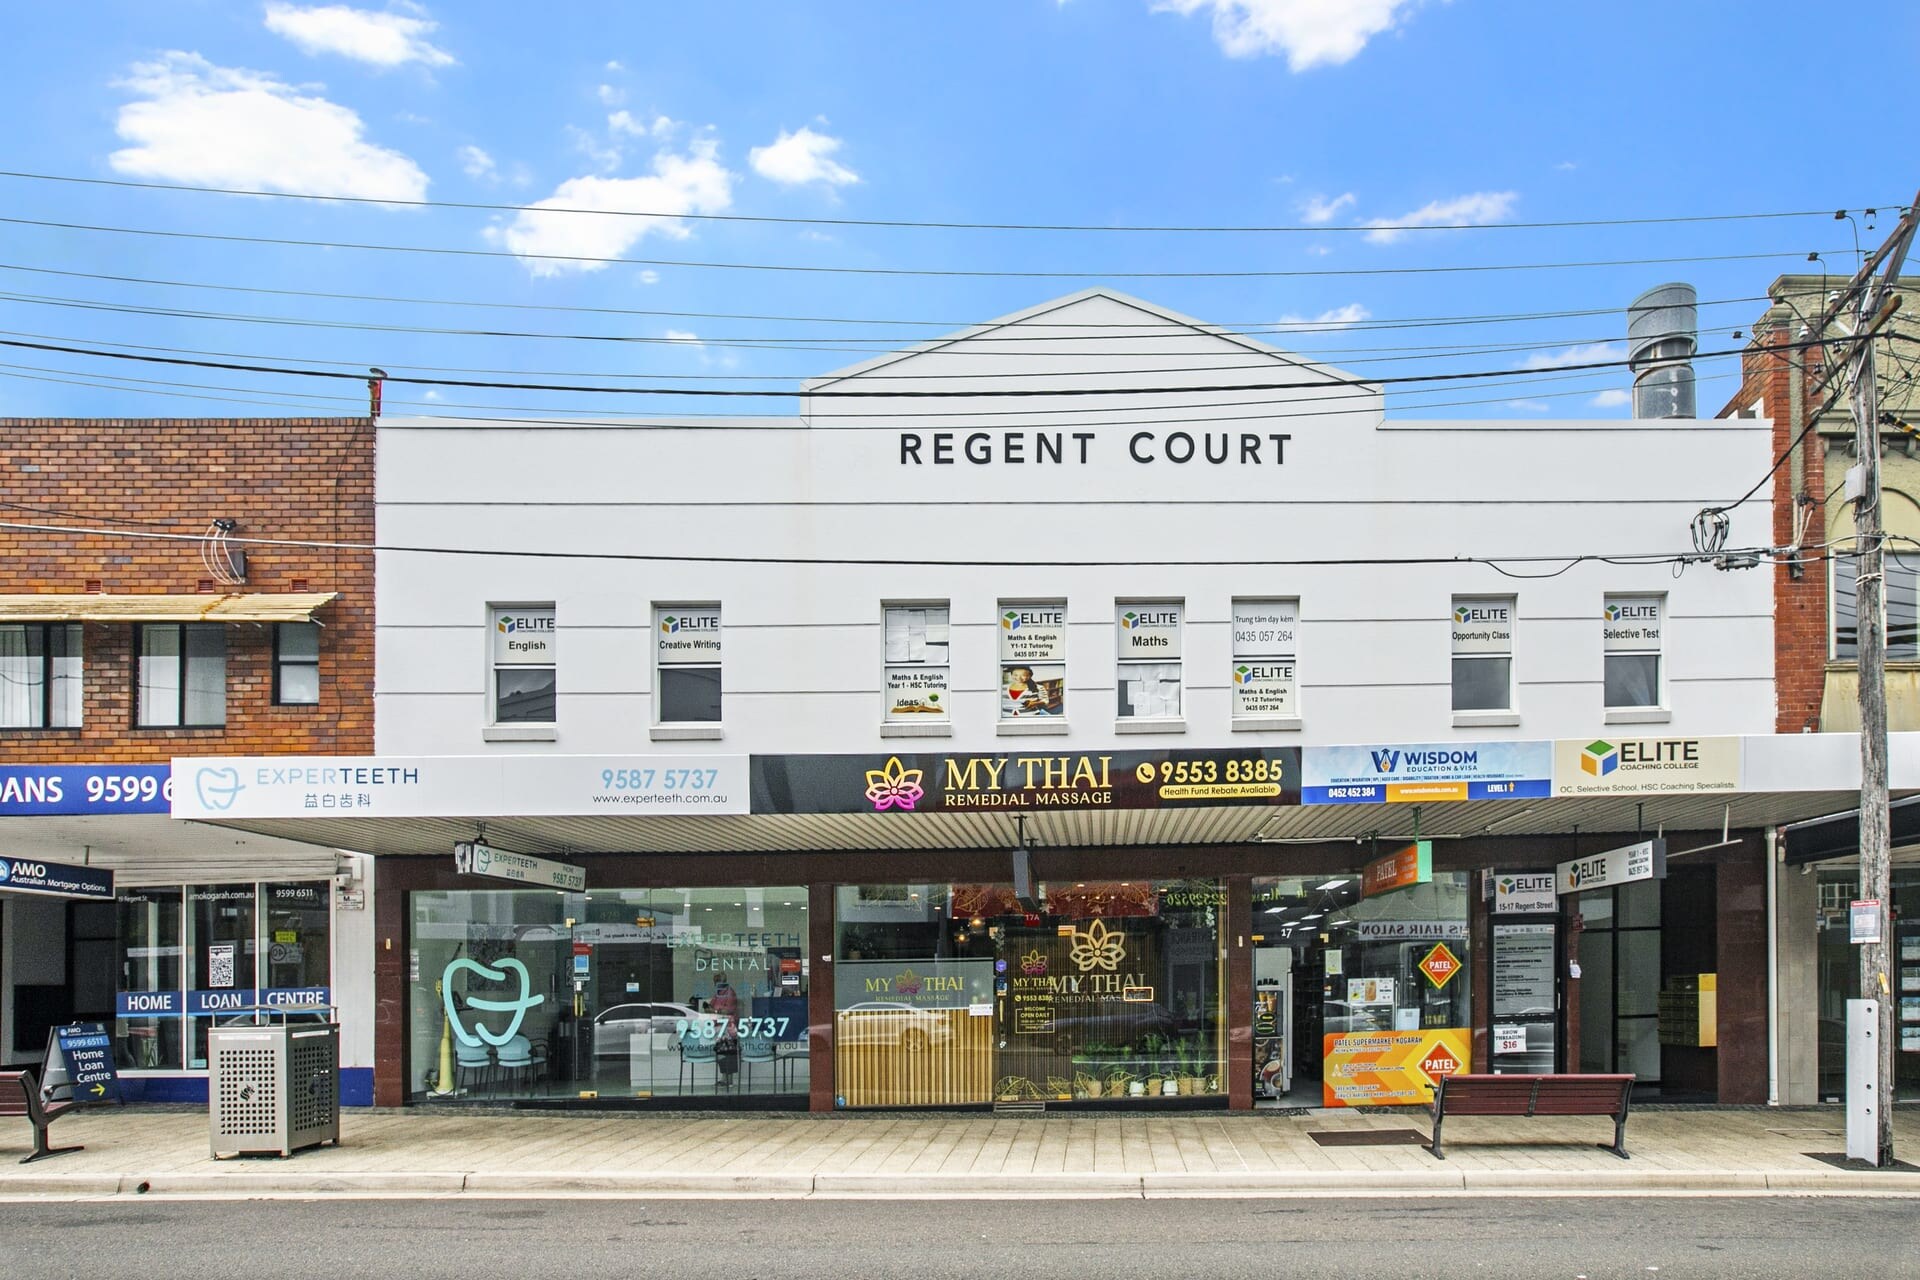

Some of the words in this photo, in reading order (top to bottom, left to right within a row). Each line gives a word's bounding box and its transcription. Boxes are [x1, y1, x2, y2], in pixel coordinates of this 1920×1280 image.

[900, 432, 1095, 464] REGENT
[1129, 432, 1292, 465] COURT
[1471, 608, 1508, 619] ELITE
[1622, 606, 1657, 617] ELITE
[516, 617, 555, 629] ELITE
[680, 616, 719, 628] ELITE
[1021, 612, 1063, 624] ELITE
[1140, 612, 1177, 624] ELITE
[1235, 615, 1253, 625] Trung
[1034, 634, 1057, 642] English
[1235, 630, 1257, 642] 0435
[1258, 630, 1275, 642] 057
[1277, 630, 1293, 642] 264
[1452, 631, 1490, 642] Opportunity
[1491, 630, 1510, 640] Class
[1603, 628, 1640, 639] Selective
[1641, 628, 1660, 639] Test
[508, 640, 546, 652] English
[659, 640, 692, 650] Creative
[693, 639, 721, 651] Writing
[1132, 635, 1168, 647] Maths
[891, 673, 911, 681] Maths
[913, 673, 918, 681] &
[920, 673, 944, 682] English
[1252, 666, 1293, 678] ELITE
[888, 681, 900, 689] Year
[902, 681, 905, 689] 1
[910, 681, 922, 689] HSC
[923, 681, 948, 690] Tutoring
[1265, 688, 1288, 696] English
[1620, 740, 1699, 762] ELITE
[1404, 750, 1477, 766] WISDOM
[1160, 760, 1217, 783] 9553
[1225, 759, 1283, 782] 8385
[1620, 763, 1662, 771] COACHING
[1663, 762, 1699, 770] COLLEGE
[257, 767, 418, 785] EXPERTEETH
[601, 769, 656, 789] 9587
[663, 769, 718, 789] 5737
[944, 758, 1009, 791] MY
[1017, 756, 1113, 790] THAI
[0, 776, 64, 802] ANS
[86, 775, 158, 802] 9599
[1164, 787, 1189, 796] Health
[1190, 787, 1210, 795] Fund
[1211, 786, 1238, 795] Rebate
[1328, 787, 1347, 798] 0452
[1347, 787, 1361, 797] 452
[1361, 786, 1375, 797] 384
[1487, 783, 1504, 792] LEVEL
[1576, 784, 1610, 793] Selective
[1641, 783, 1659, 791] HSC
[1660, 781, 1695, 792] Coaching
[592, 793, 728, 805] www.experteeth.com.au
[945, 793, 1030, 807] REMEDIAL
[1035, 791, 1112, 805] MASSAGE
[494, 852, 538, 869] EXPERTEETH
[11, 862, 46, 878] AMO
[1376, 859, 1397, 882] PATEL
[1581, 858, 1607, 879] ELITE
[10, 875, 46, 886] Australian
[47, 879, 80, 890] Mortgage
[81, 882, 106, 892] Options
[552, 872, 567, 883] 9587
[568, 874, 583, 888] 5737
[1516, 877, 1553, 889] ELITE
[190, 890, 255, 902] amokogarah.com.au
[276, 889, 296, 898] 9599
[296, 888, 314, 897] 6511
[1499, 902, 1514, 911] 15-17
[1515, 902, 1536, 912] Regent
[1536, 901, 1553, 909] Street
[1281, 928, 1293, 939] 17
[666, 933, 801, 948] EXPERTEETH
[696, 957, 771, 972] DENTAL
[1429, 961, 1452, 969] PATEL
[865, 977, 892, 992] MY
[923, 976, 964, 991] THAI
[1013, 977, 1030, 987] MY
[1049, 975, 1084, 994] MY
[1090, 973, 1146, 993] THAI
[128, 995, 172, 1011] HOME
[201, 993, 242, 1009] LOAN
[266, 990, 324, 1005] CENTRE
[875, 994, 912, 1002] REMEDIAL
[675, 1017, 730, 1039] 9587
[736, 1016, 790, 1038] 5737
[67, 1039, 87, 1048] 9599
[87, 1037, 104, 1046] 6511
[1334, 1038, 1351, 1047] PATEL
[1352, 1037, 1395, 1046] SUPERMARKET
[1395, 1036, 1423, 1045] KOGARAH
[1503, 1040, 1518, 1050] $16
[72, 1050, 105, 1061] Home
[78, 1061, 105, 1072] Loan
[1425, 1059, 1456, 1070] PATEL
[76, 1071, 112, 1083] Centre
